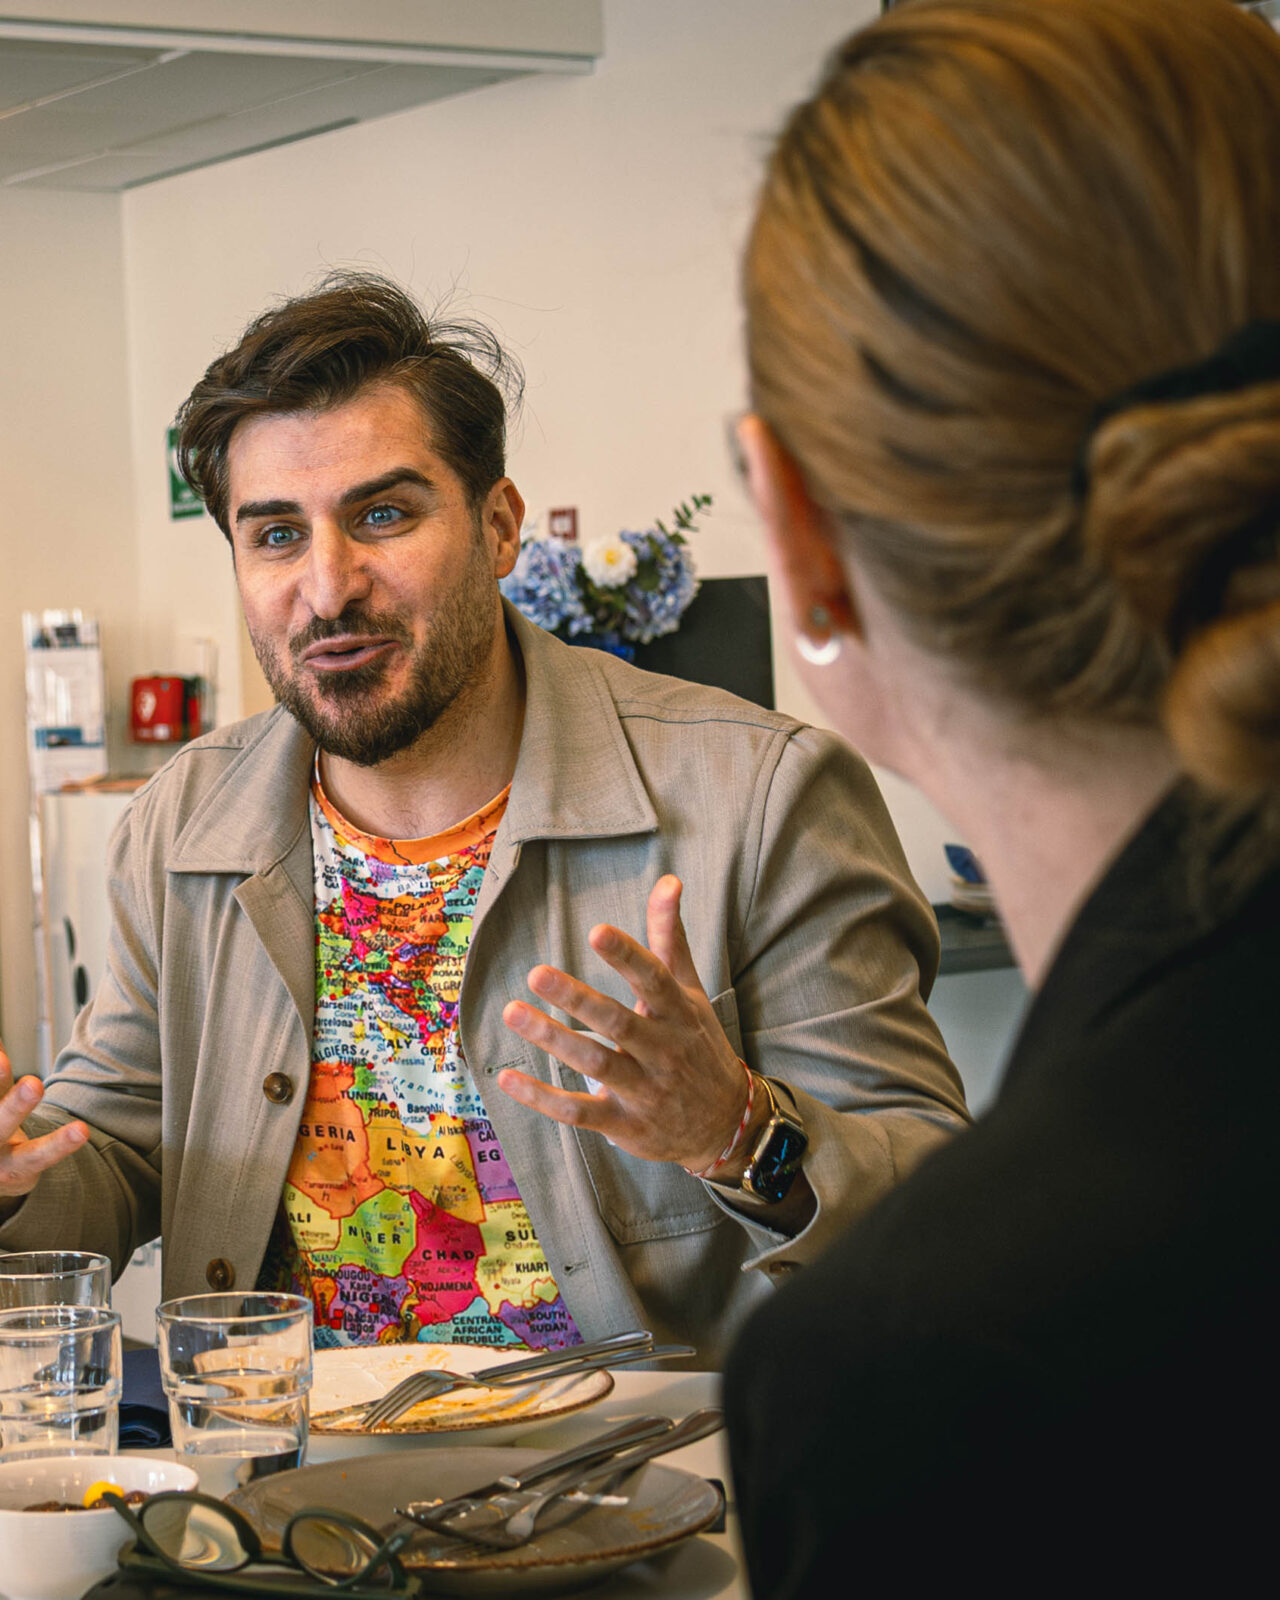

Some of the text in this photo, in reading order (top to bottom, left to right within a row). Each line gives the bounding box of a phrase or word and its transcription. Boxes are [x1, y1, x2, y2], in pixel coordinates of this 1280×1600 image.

[394, 896, 440, 911] POLAND
[312, 1044, 357, 1062] ALGIERS
[340, 1090, 388, 1102] TUNISIA
[299, 1124, 356, 1142] GERIA
[386, 1137, 445, 1159] LIBYA
[477, 1149, 501, 1163] EG
[348, 1225, 401, 1245] NIGER
[422, 1249, 475, 1261] CHAD
[421, 1280, 473, 1292] NDJAMENA
[452, 1315, 501, 1325] CENTRAL
[528, 1310, 566, 1321] SOUTH
[453, 1325, 502, 1335] AFRICAN
[529, 1323, 568, 1334] SUDAN
[452, 1335, 505, 1344] REPUBLIC
